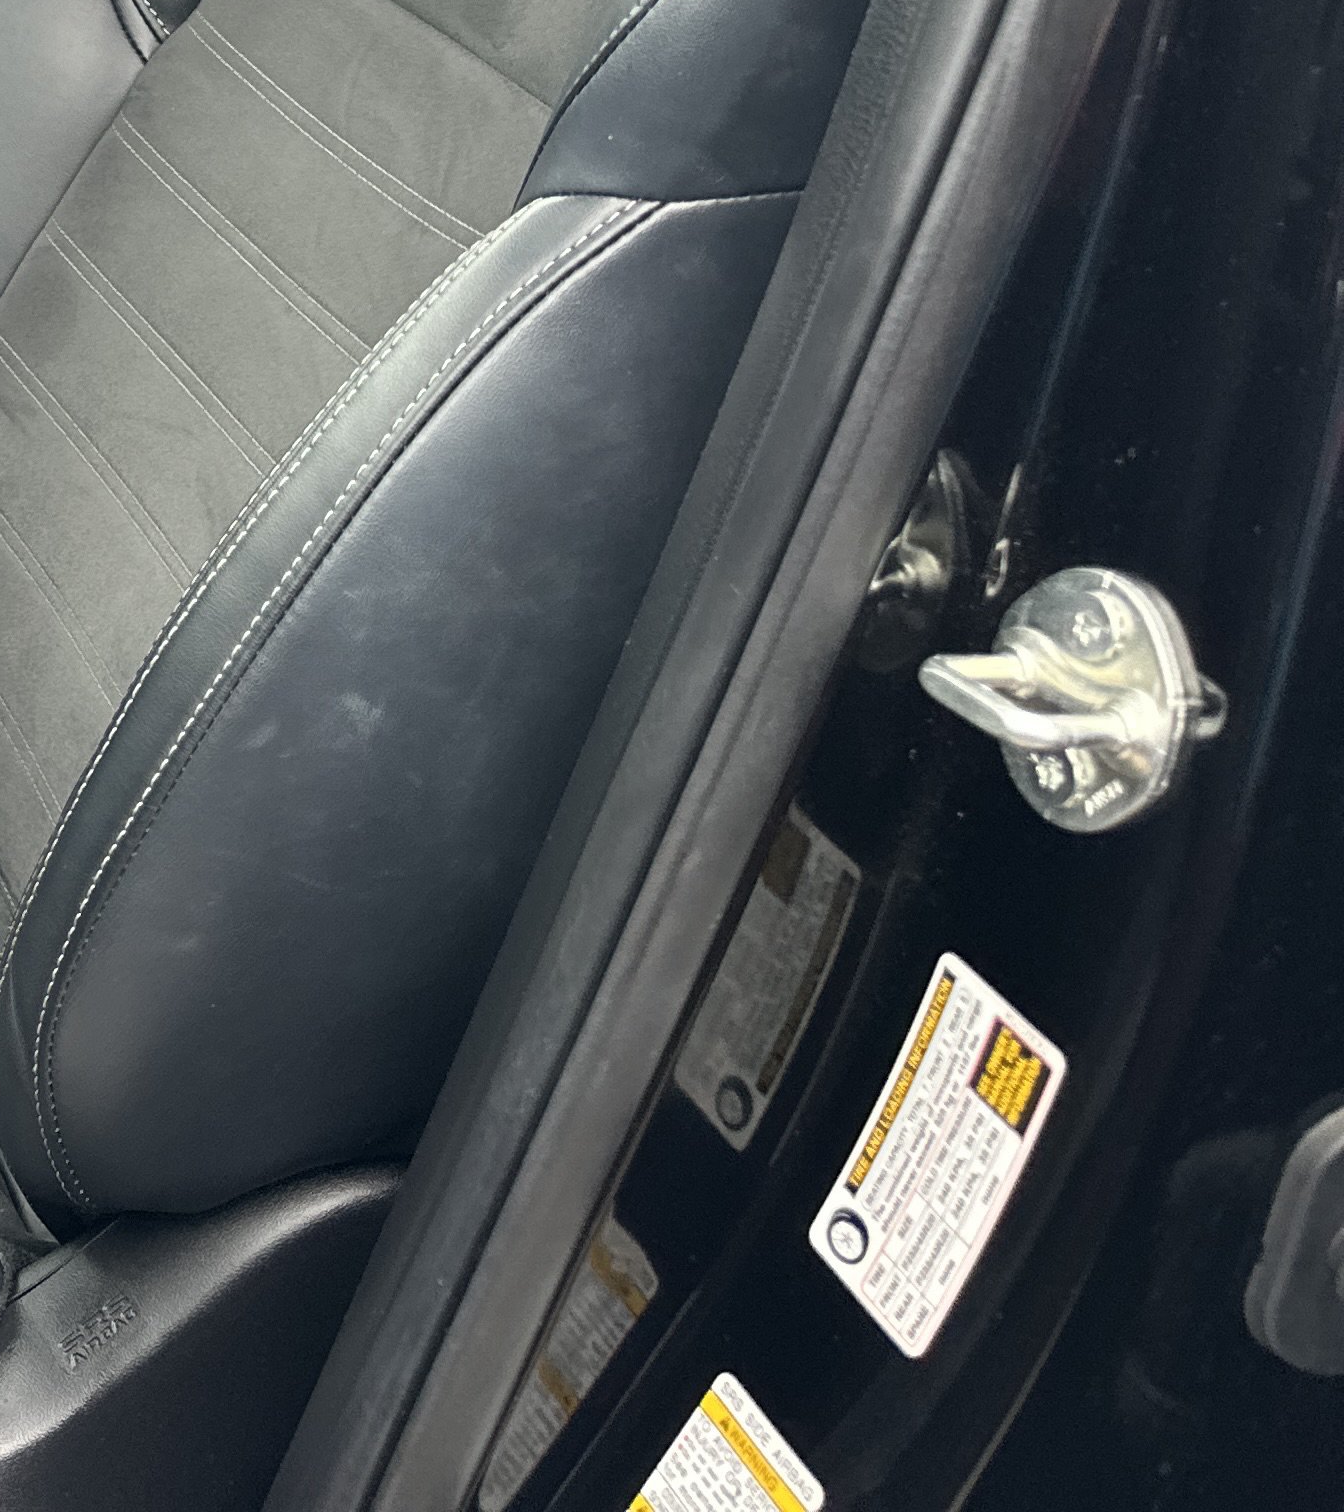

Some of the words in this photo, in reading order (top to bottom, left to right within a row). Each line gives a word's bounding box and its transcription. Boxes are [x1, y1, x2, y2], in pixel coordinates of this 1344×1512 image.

[864, 1125, 883, 1157] AND
[878, 1067, 912, 1128] LOADING
[907, 977, 951, 1069] INFORMATION
[68, 1308, 138, 1370] AIRBAG
[720, 1381, 745, 1412] SRS
[745, 1413, 772, 1448] SIDE
[771, 1449, 814, 1502] AIRBAG
[731, 1431, 778, 1492] WARNING
